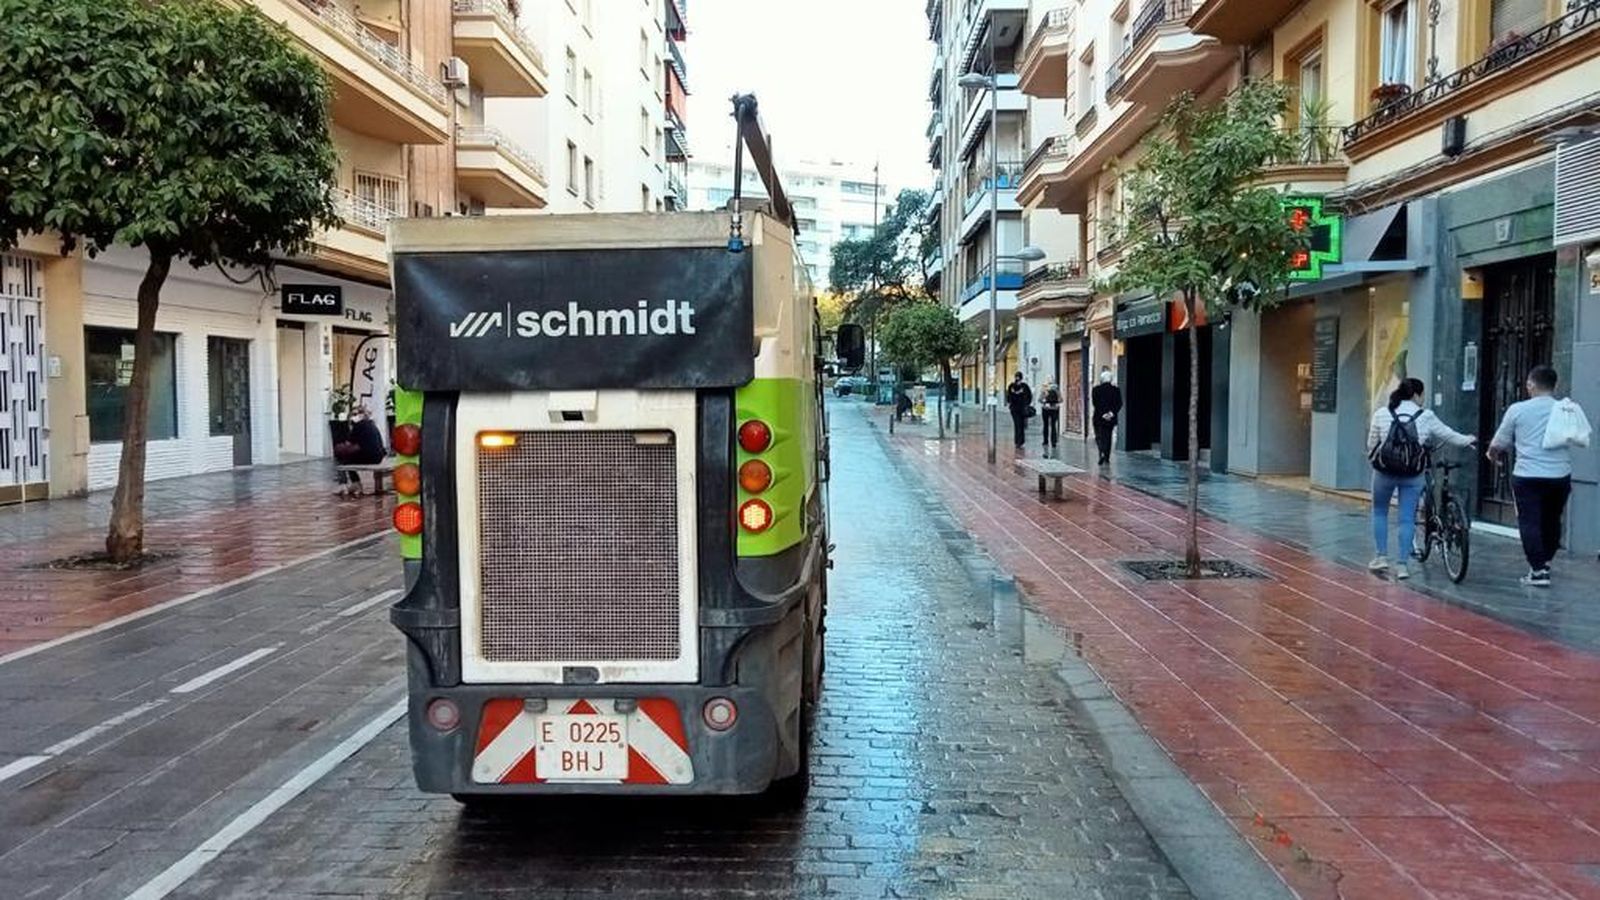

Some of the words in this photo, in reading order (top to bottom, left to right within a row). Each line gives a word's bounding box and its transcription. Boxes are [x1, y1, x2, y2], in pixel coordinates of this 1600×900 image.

[288, 293, 335, 306] FLAG
[345, 308, 373, 322] FLAG
[516, 299, 696, 337] schmidt
[542, 721, 555, 744] E
[570, 722, 621, 743] 0225
[562, 750, 603, 772] BHJ
